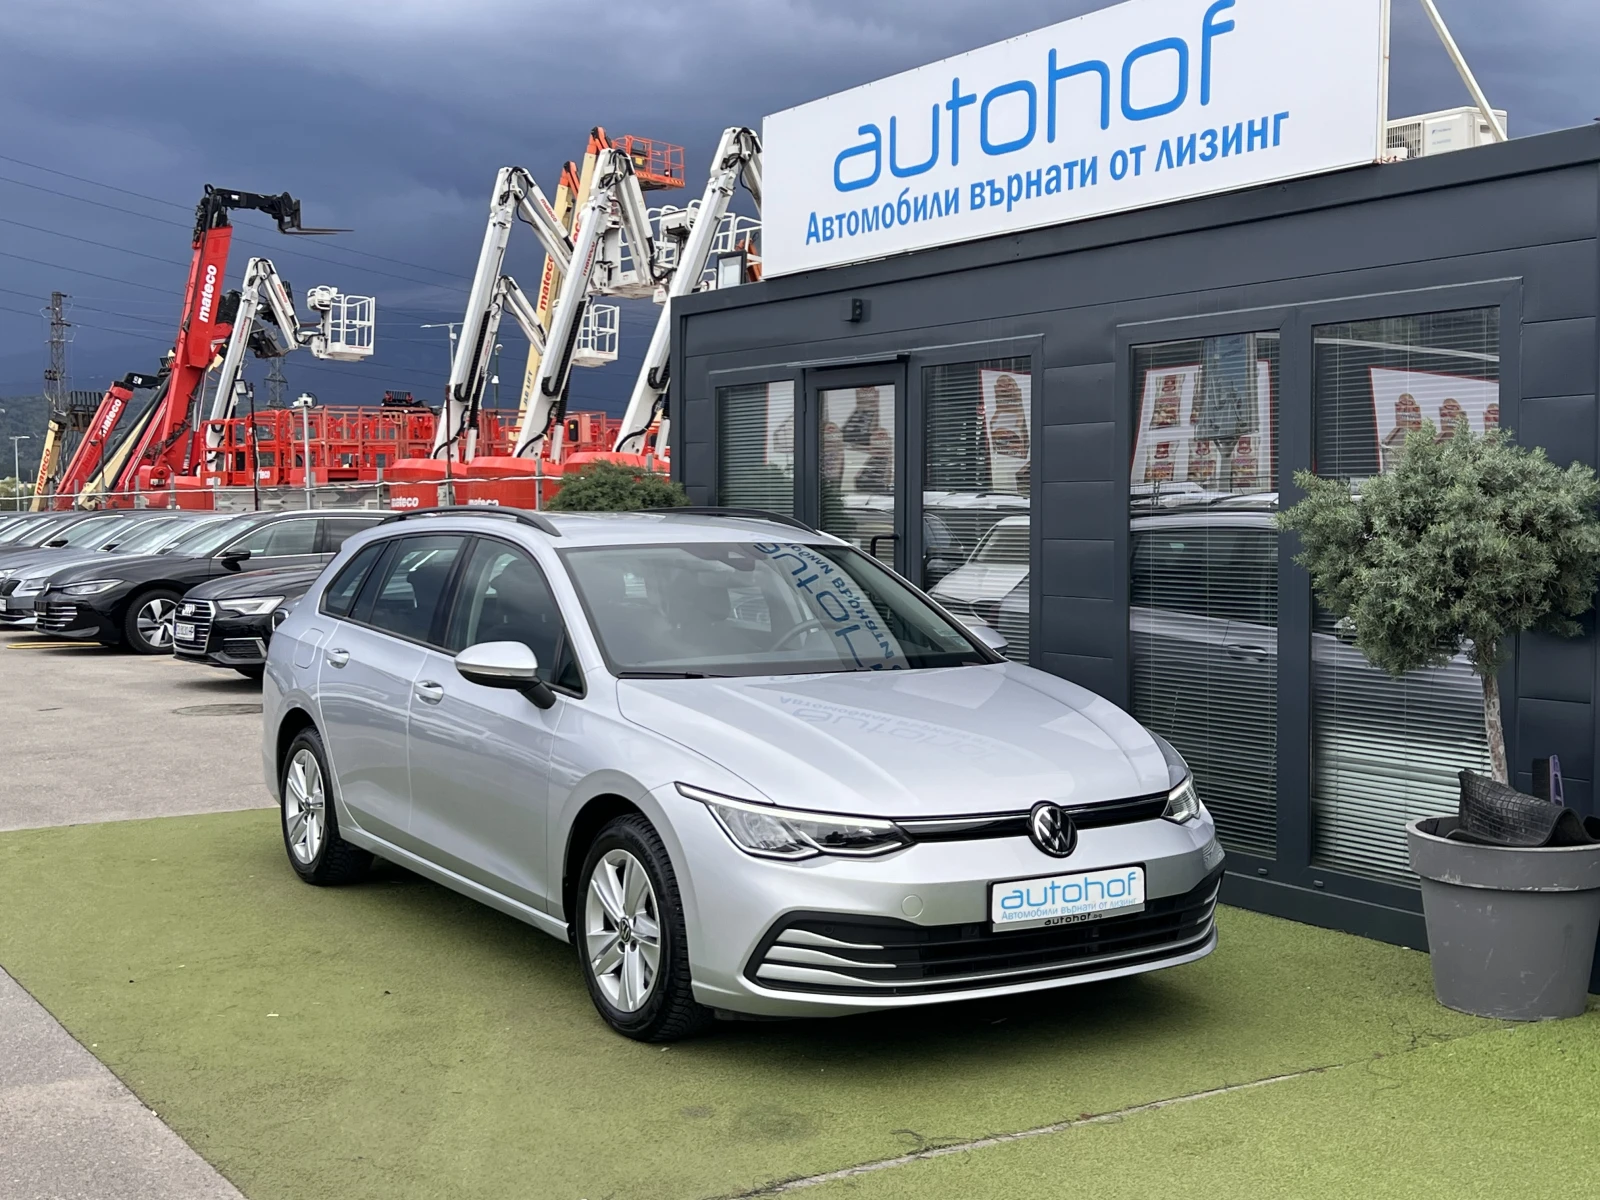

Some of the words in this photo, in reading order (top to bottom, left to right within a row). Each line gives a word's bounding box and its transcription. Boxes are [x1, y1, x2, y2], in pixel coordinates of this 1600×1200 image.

[834, 0, 1235, 192] autohof
[806, 187, 959, 244] Автомобили
[970, 156, 1097, 212] върнати
[1109, 145, 1146, 182] от
[1155, 111, 1290, 174] лизинг
[198, 264, 218, 323] mateco
[36, 448, 51, 495] mateco
[1000, 871, 1137, 910] autohof
[1001, 906, 1058, 921] Автомобили
[1060, 900, 1097, 915] върнати
[1098, 900, 1108, 910] от
